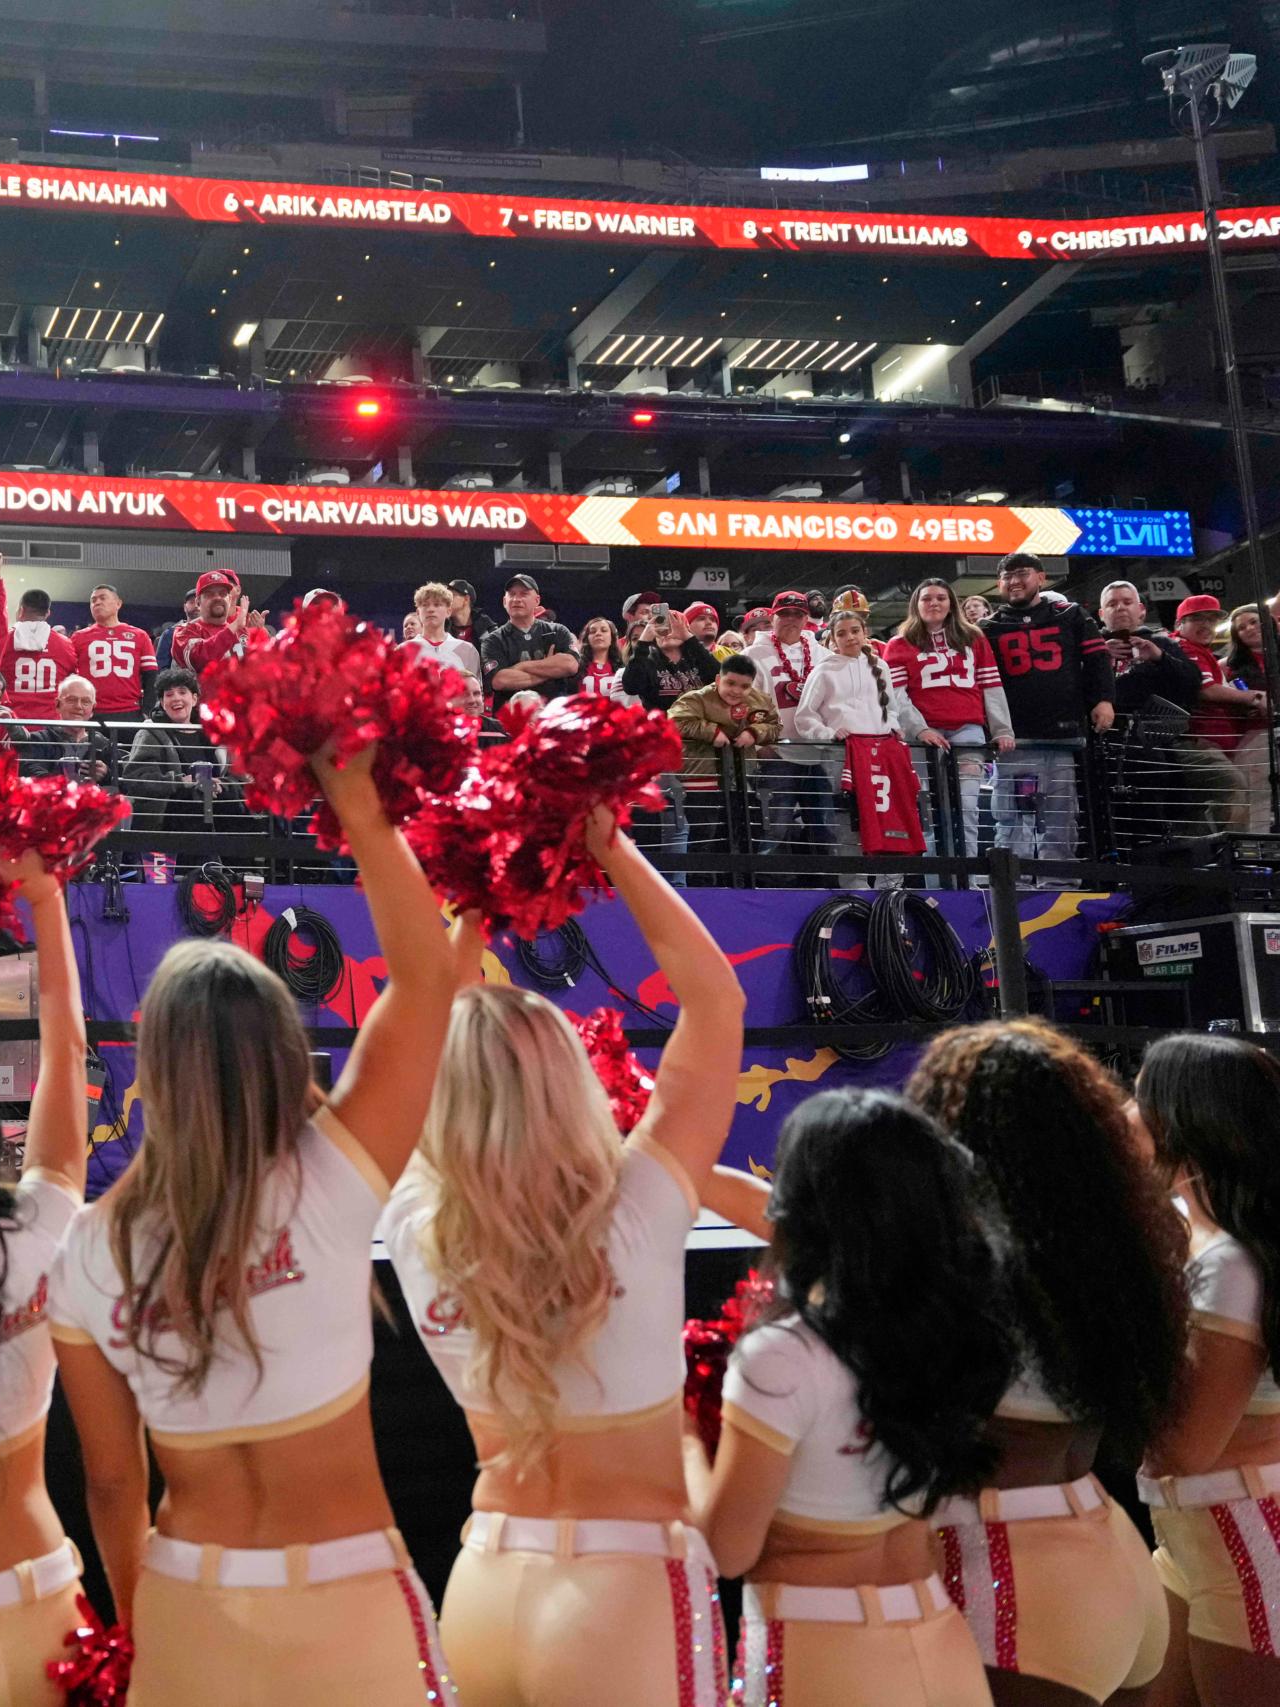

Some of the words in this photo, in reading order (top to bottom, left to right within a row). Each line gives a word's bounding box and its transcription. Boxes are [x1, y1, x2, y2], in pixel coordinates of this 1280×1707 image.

[26, 177, 167, 208] SHANAHAN
[223, 192, 239, 213] 6
[259, 193, 318, 217] ARIK
[319, 197, 452, 224] ARMSTEAD
[499, 207, 514, 227] 7
[533, 209, 592, 231] FRED
[594, 212, 696, 237] WARNER
[743, 220, 758, 239] 8
[779, 220, 852, 243] TRENT
[854, 223, 968, 247] WILLIAMS
[1017, 230, 1033, 249] 9
[1050, 224, 1185, 251] CHRISTIAN
[77, 490, 166, 516] AIYUK
[215, 497, 236, 520] 11
[261, 498, 439, 527] CHARVARIUS
[441, 504, 527, 530] WARD
[656, 510, 718, 537] SAN
[727, 513, 899, 541] FRANCISCO
[908, 518, 995, 543] 49ERS
[1113, 516, 1139, 524] SUPER
[1113, 524, 1169, 546] LVIII
[658, 570, 681, 581] 138
[703, 571, 726, 582] 139
[1151, 580, 1175, 591] 139
[1199, 579, 1223, 590] 140
[88, 639, 136, 679] 85
[998, 626, 1063, 677] 85
[14, 656, 57, 693] 80
[916, 645, 976, 689] 23
[871, 774, 891, 813] 3
[1155, 941, 1199, 955] FILMS
[1143, 965, 1168, 977] NEAR
[1170, 963, 1194, 975] LEFT
